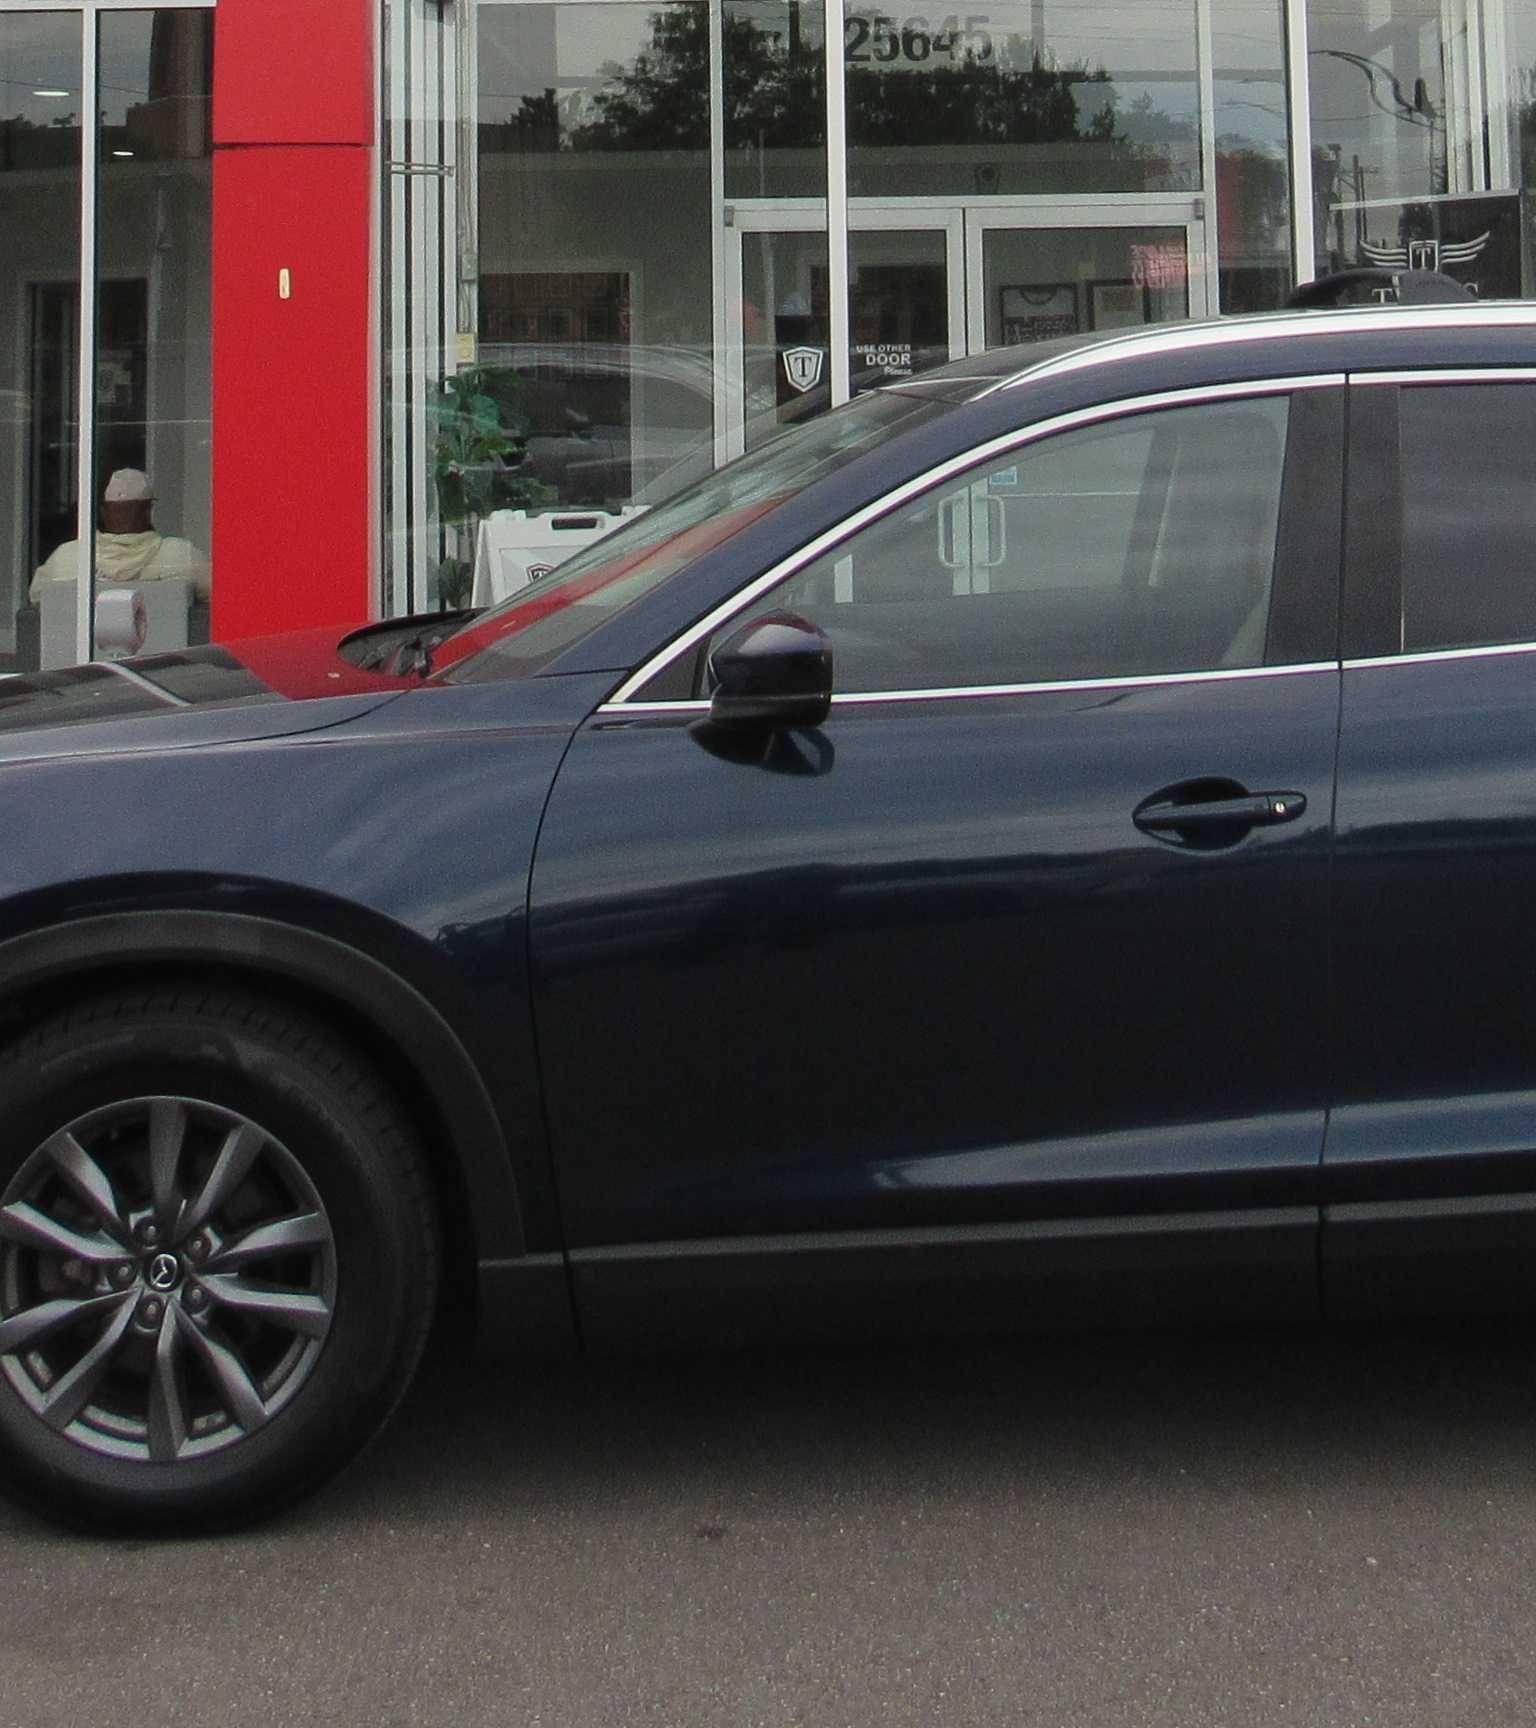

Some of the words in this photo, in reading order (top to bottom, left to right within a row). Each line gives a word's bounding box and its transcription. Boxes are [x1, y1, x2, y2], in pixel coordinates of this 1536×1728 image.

[844, 15, 993, 63] 25645
[856, 344, 877, 354] USE
[878, 343, 911, 352] OTHER
[794, 355, 812, 378] T
[866, 352, 911, 366] DOOR
